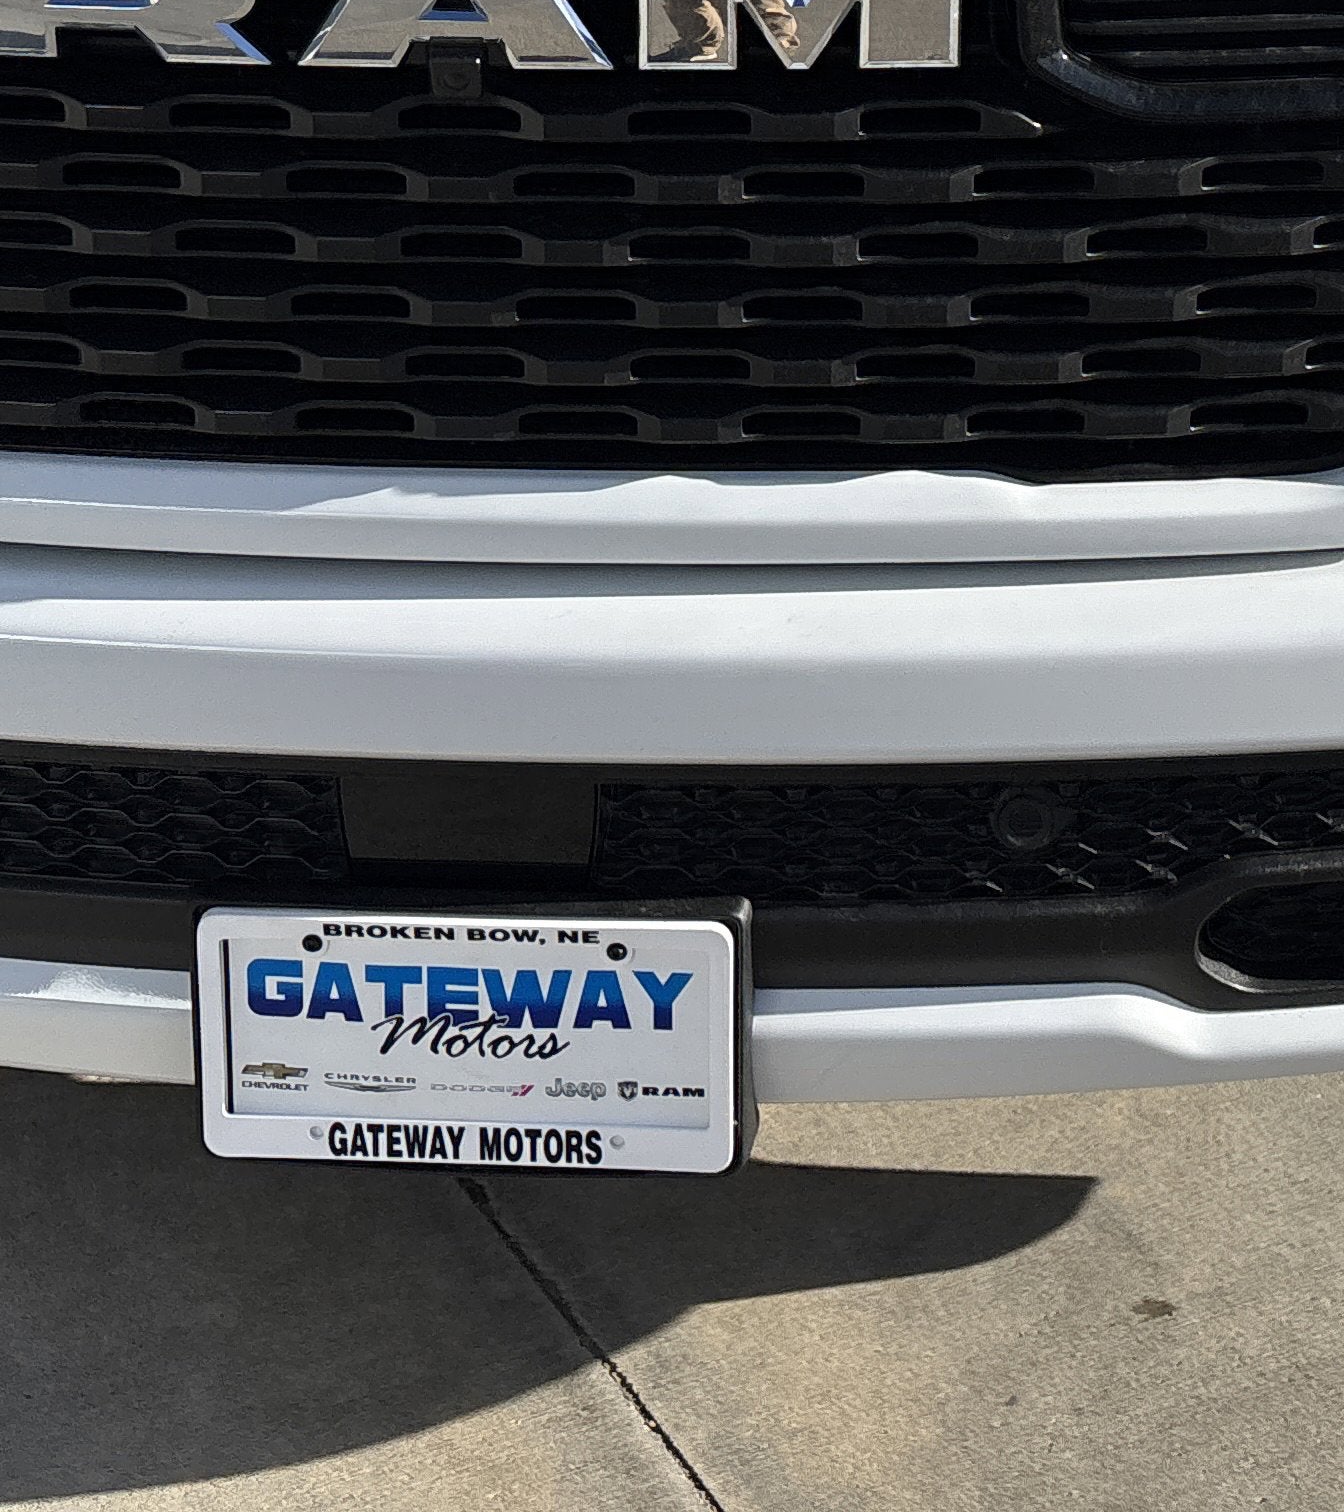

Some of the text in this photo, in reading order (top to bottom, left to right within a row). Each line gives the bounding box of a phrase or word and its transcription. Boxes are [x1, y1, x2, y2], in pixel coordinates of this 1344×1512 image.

[323, 923, 600, 946] BROKEN BOW, NE
[247, 958, 694, 1031] GATEWAY
[370, 1013, 571, 1059] Motors
[241, 1080, 309, 1092] CHEVROLET
[324, 1072, 417, 1084] CHRYSLER
[545, 1078, 607, 1101] Jeep
[642, 1086, 705, 1097] RAM
[328, 1122, 603, 1165] GATEWAY MOTORS
